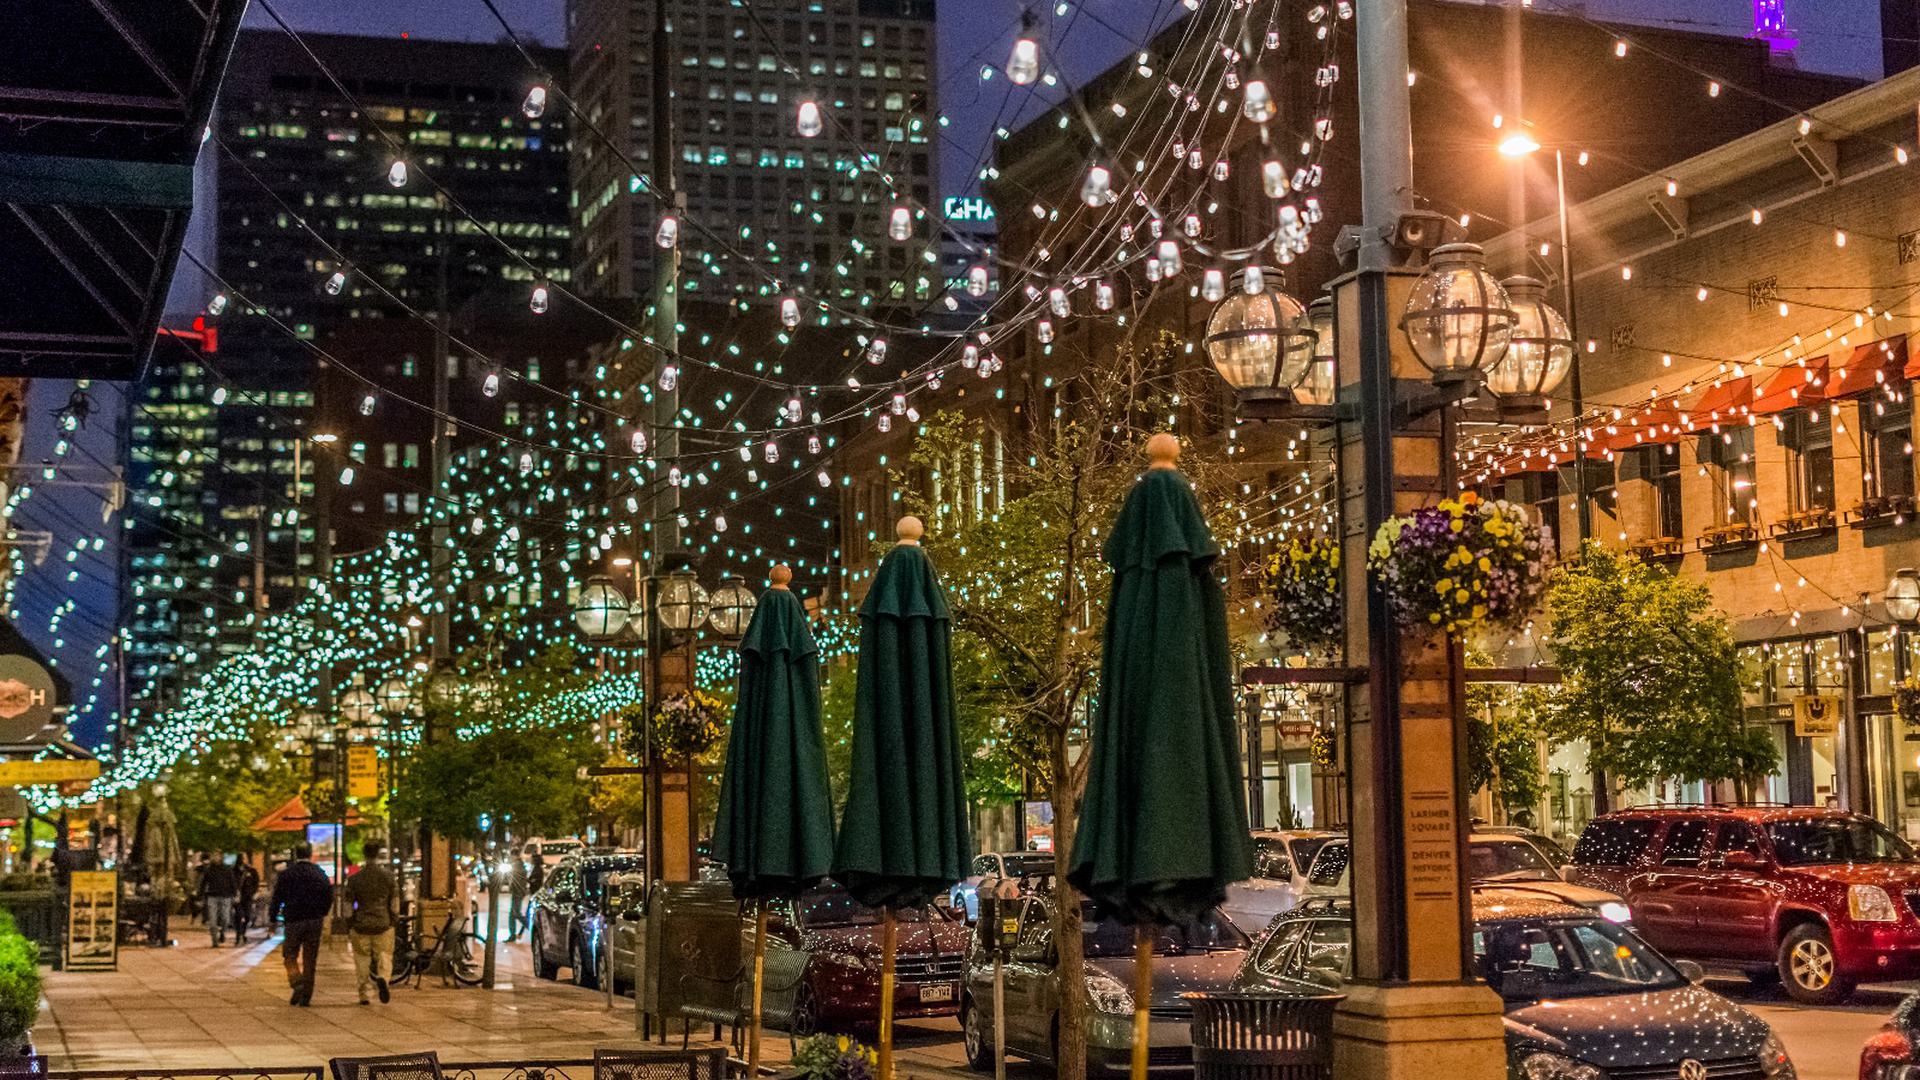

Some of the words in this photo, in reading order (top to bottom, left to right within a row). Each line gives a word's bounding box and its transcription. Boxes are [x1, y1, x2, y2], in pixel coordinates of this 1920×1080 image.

[1411, 809, 1449, 818] LARIMER
[1411, 823, 1451, 832] SQUARE
[1412, 851, 1451, 860] DENVER
[1413, 864, 1452, 873] HISTORIC
